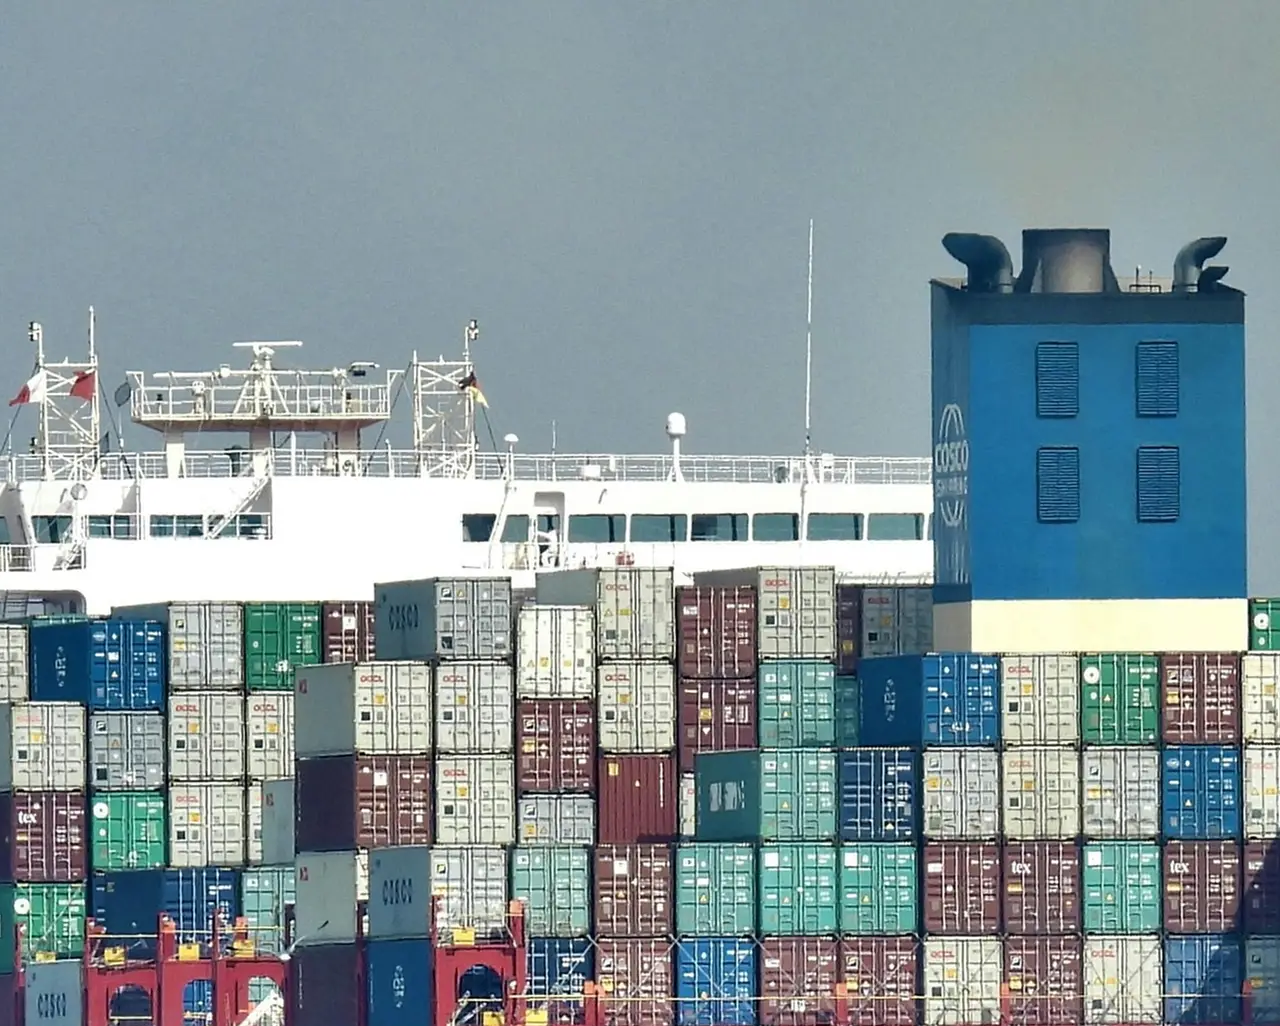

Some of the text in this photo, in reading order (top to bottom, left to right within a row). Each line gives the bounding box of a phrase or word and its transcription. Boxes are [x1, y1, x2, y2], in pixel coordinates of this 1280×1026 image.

[935, 440, 969, 473] COSCO
[18, 811, 37, 824] tex
[1011, 860, 1031, 874] tex
[1170, 860, 1190, 874] tex
